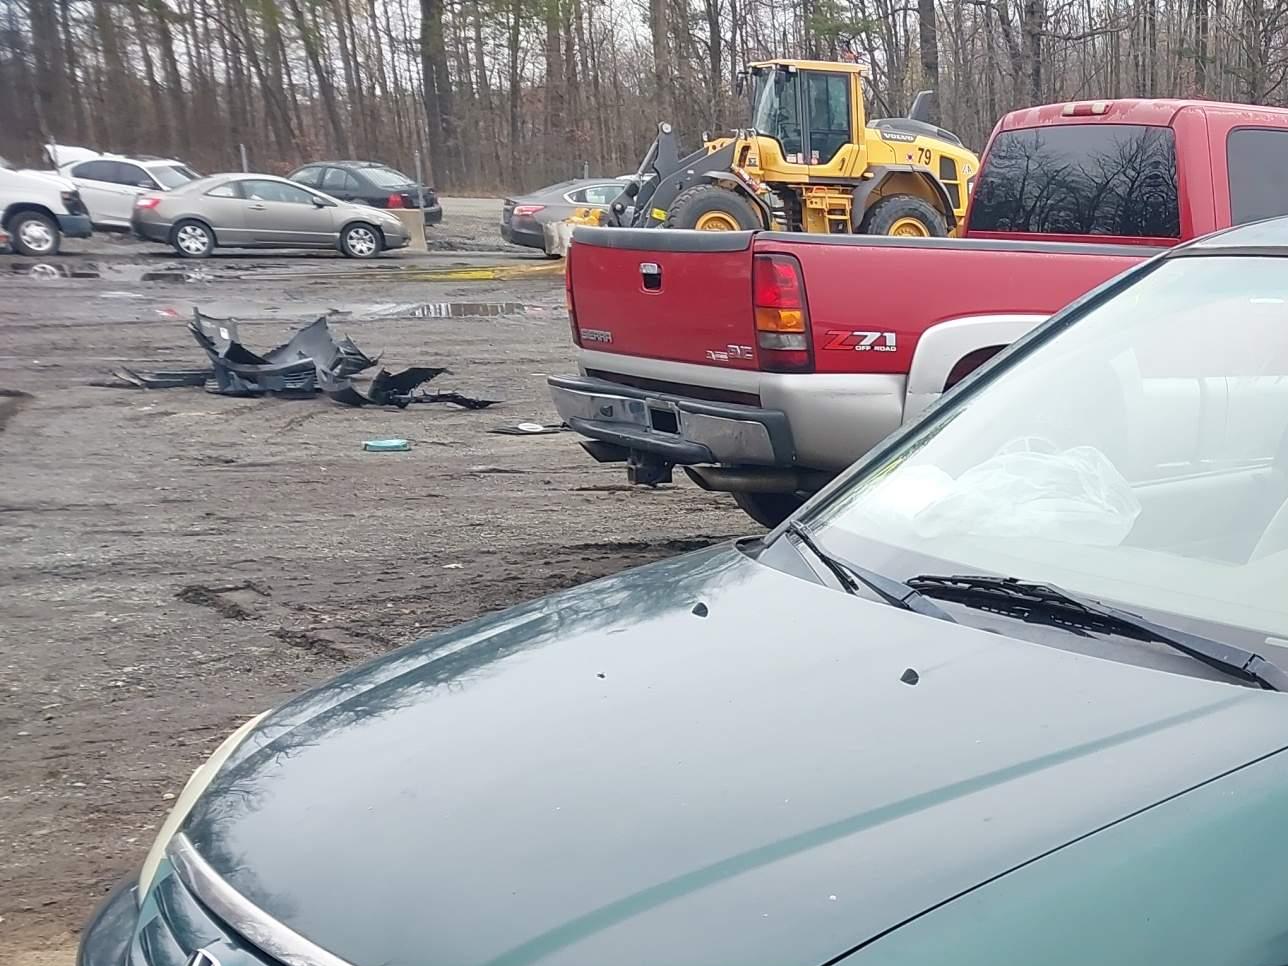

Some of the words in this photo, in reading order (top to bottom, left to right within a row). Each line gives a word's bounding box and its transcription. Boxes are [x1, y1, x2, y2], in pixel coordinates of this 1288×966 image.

[882, 132, 914, 141] VOLVO
[917, 147, 932, 166] 79
[823, 330, 896, 350] Z71
